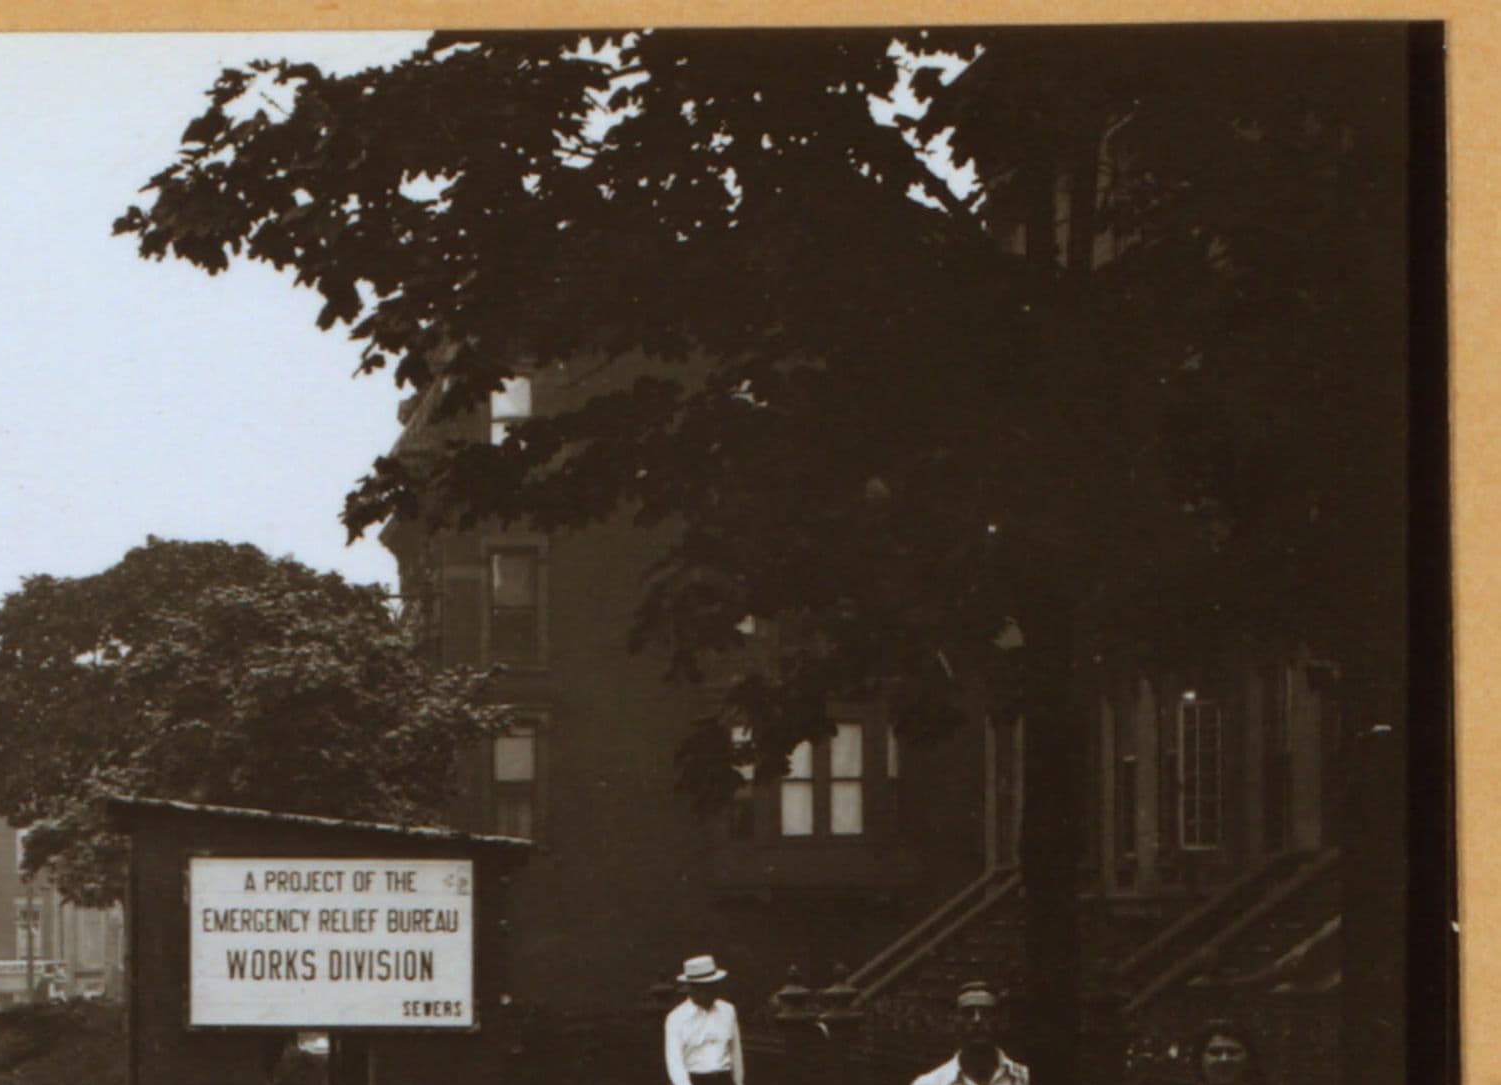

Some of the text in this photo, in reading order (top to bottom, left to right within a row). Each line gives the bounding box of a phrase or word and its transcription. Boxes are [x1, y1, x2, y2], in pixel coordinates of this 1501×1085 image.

[244, 870, 416, 892] A PROJECT OF THE
[202, 908, 459, 933] EMERGENCY RELIEF BUREAU
[227, 949, 434, 982] WORKS DIVISION
[403, 1000, 462, 1017] SEWERS
